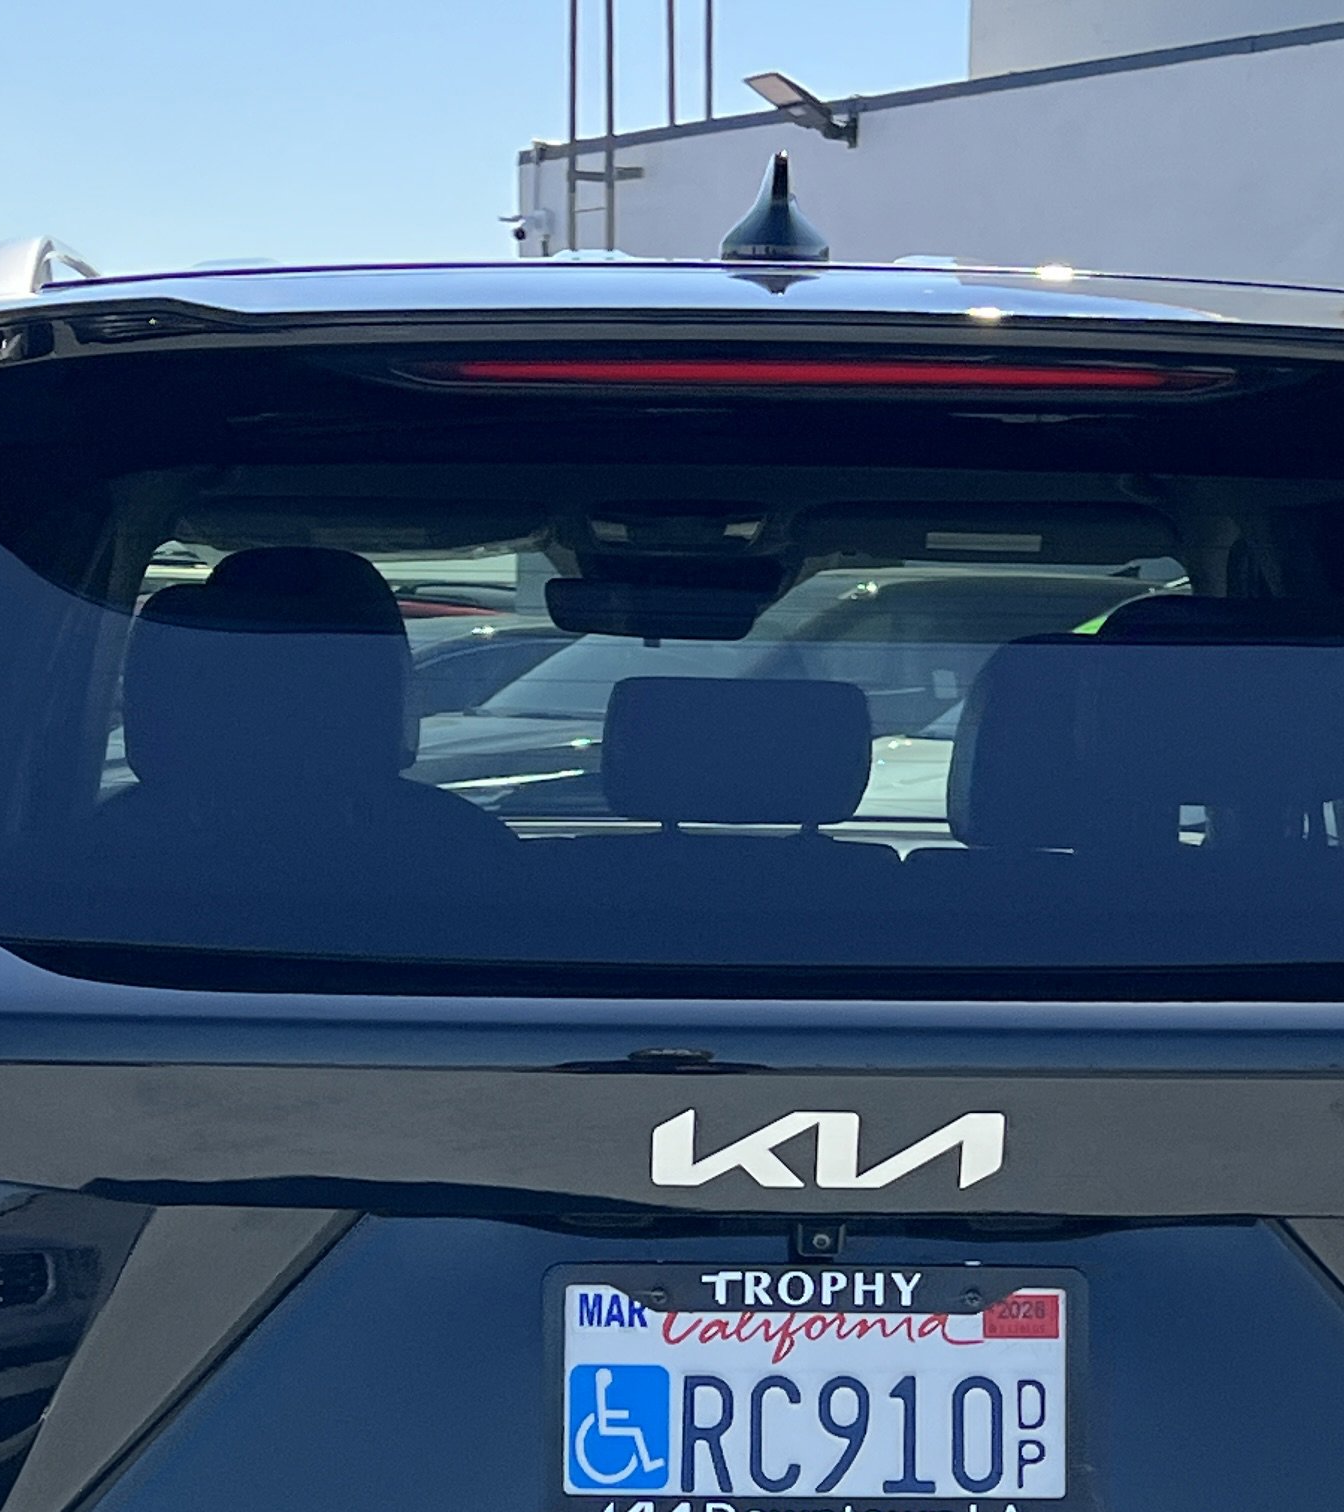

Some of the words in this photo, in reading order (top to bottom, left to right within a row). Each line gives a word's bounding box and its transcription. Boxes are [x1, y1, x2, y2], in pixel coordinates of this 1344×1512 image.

[651, 1108, 1005, 1189] KIA
[579, 1293, 648, 1328] MAR
[701, 1271, 923, 1307] TROPHY
[662, 1311, 984, 1364] California
[680, 1375, 1004, 1494] RC910
